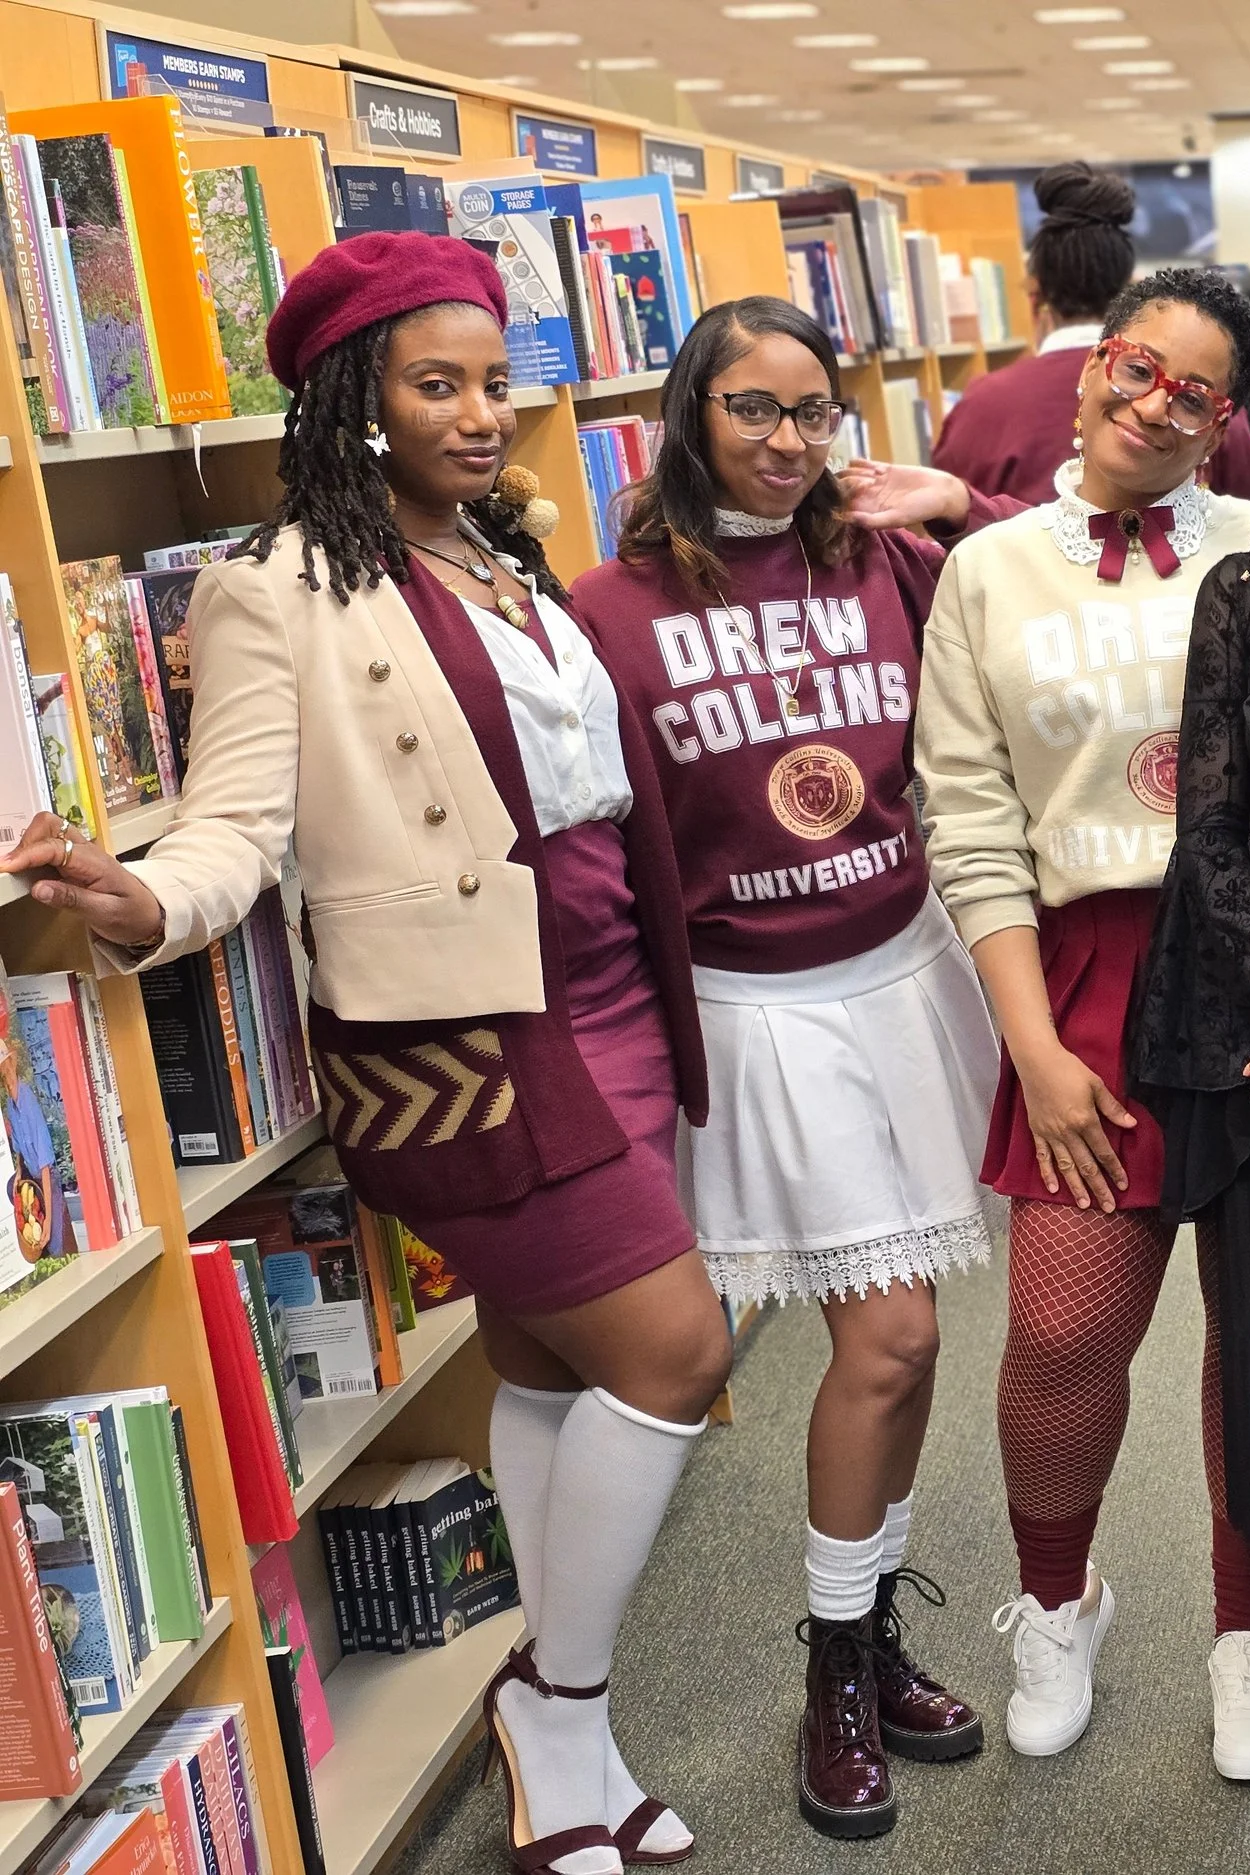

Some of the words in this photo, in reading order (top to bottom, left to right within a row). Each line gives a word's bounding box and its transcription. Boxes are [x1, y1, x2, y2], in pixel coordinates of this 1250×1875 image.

[162, 54, 198, 74] MEMBERS
[198, 62, 219, 79] EARN
[219, 67, 246, 84] STAMPS
[369, 101, 397, 132] Crafts
[399, 106, 408, 133] &
[408, 108, 442, 138] Hobbies
[169, 108, 205, 257] FLOWER
[463, 193, 487, 202] MULTI
[463, 201, 490, 214] COIN
[501, 190, 535, 202] STORAGE
[507, 200, 532, 211] PAGES
[18, 250, 40, 330] DESIGN
[652, 597, 868, 688] DREW
[12, 646, 34, 719] bonsai
[652, 663, 911, 765] COLLINS
[785, 750, 812, 764] Collins
[815, 748, 853, 771] University
[99, 1461, 109, 1487] HOW
[107, 1506, 119, 1551] CREATE
[119, 1580, 132, 1627] GARDEN
[172, 1454, 186, 1512] URBAN
[181, 1517, 199, 1603] BOTANICS
[377, 1532, 390, 1563] getting
[431, 1506, 472, 1540] getting
[327, 1533, 339, 1564] getting
[333, 1566, 344, 1592] baked
[346, 1529, 358, 1560] getting
[352, 1562, 362, 1588] baked
[361, 1530, 373, 1562] getting
[367, 1564, 378, 1590] baked
[383, 1566, 394, 1592] baked
[401, 1527, 413, 1558] getting
[407, 1560, 418, 1587] baked
[418, 1525, 429, 1556] getting
[424, 1558, 434, 1584] baked
[11, 1517, 36, 1588] Plant
[27, 1584, 50, 1653] Tribe
[226, 1733, 251, 1840] LILACS
[240, 1719, 260, 1805] LILIES
[203, 1757, 229, 1875] DAHLIAS
[214, 1744, 241, 1862] DAHLIAS
[133, 1835, 150, 1861] Erica
